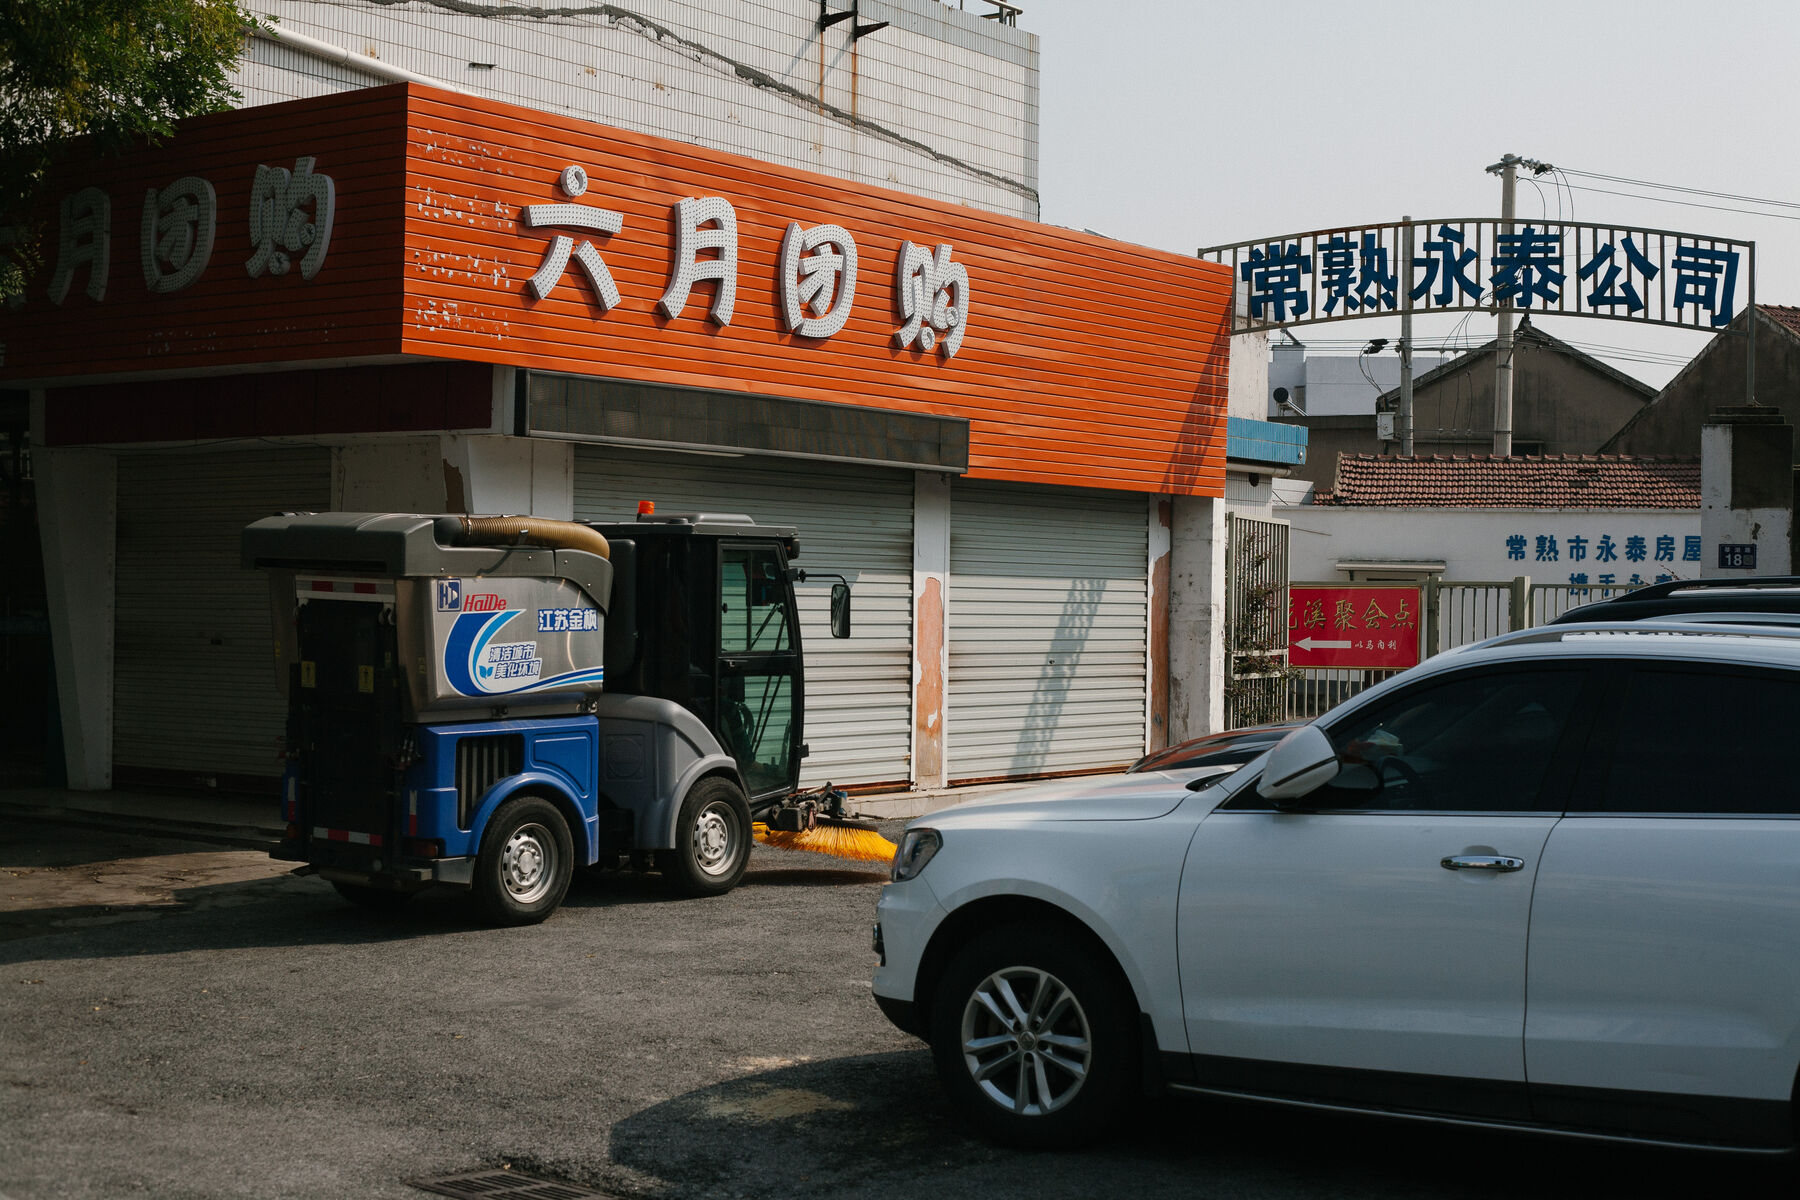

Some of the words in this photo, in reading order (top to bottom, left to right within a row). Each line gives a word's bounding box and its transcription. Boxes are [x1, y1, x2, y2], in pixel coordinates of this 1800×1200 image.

[0, 155, 336, 311] 月团购
[523, 165, 970, 359] 六月团购
[1241, 224, 1741, 328] 常熟永泰公司
[1506, 534, 1701, 562] 常熟市永泰房屋
[1724, 553, 1743, 566] 18
[463, 594, 507, 612] HaiDe
[538, 608, 598, 632] 江苏金枫
[488, 644, 536, 663] 清洁城市
[494, 660, 541, 679] 美化环境
